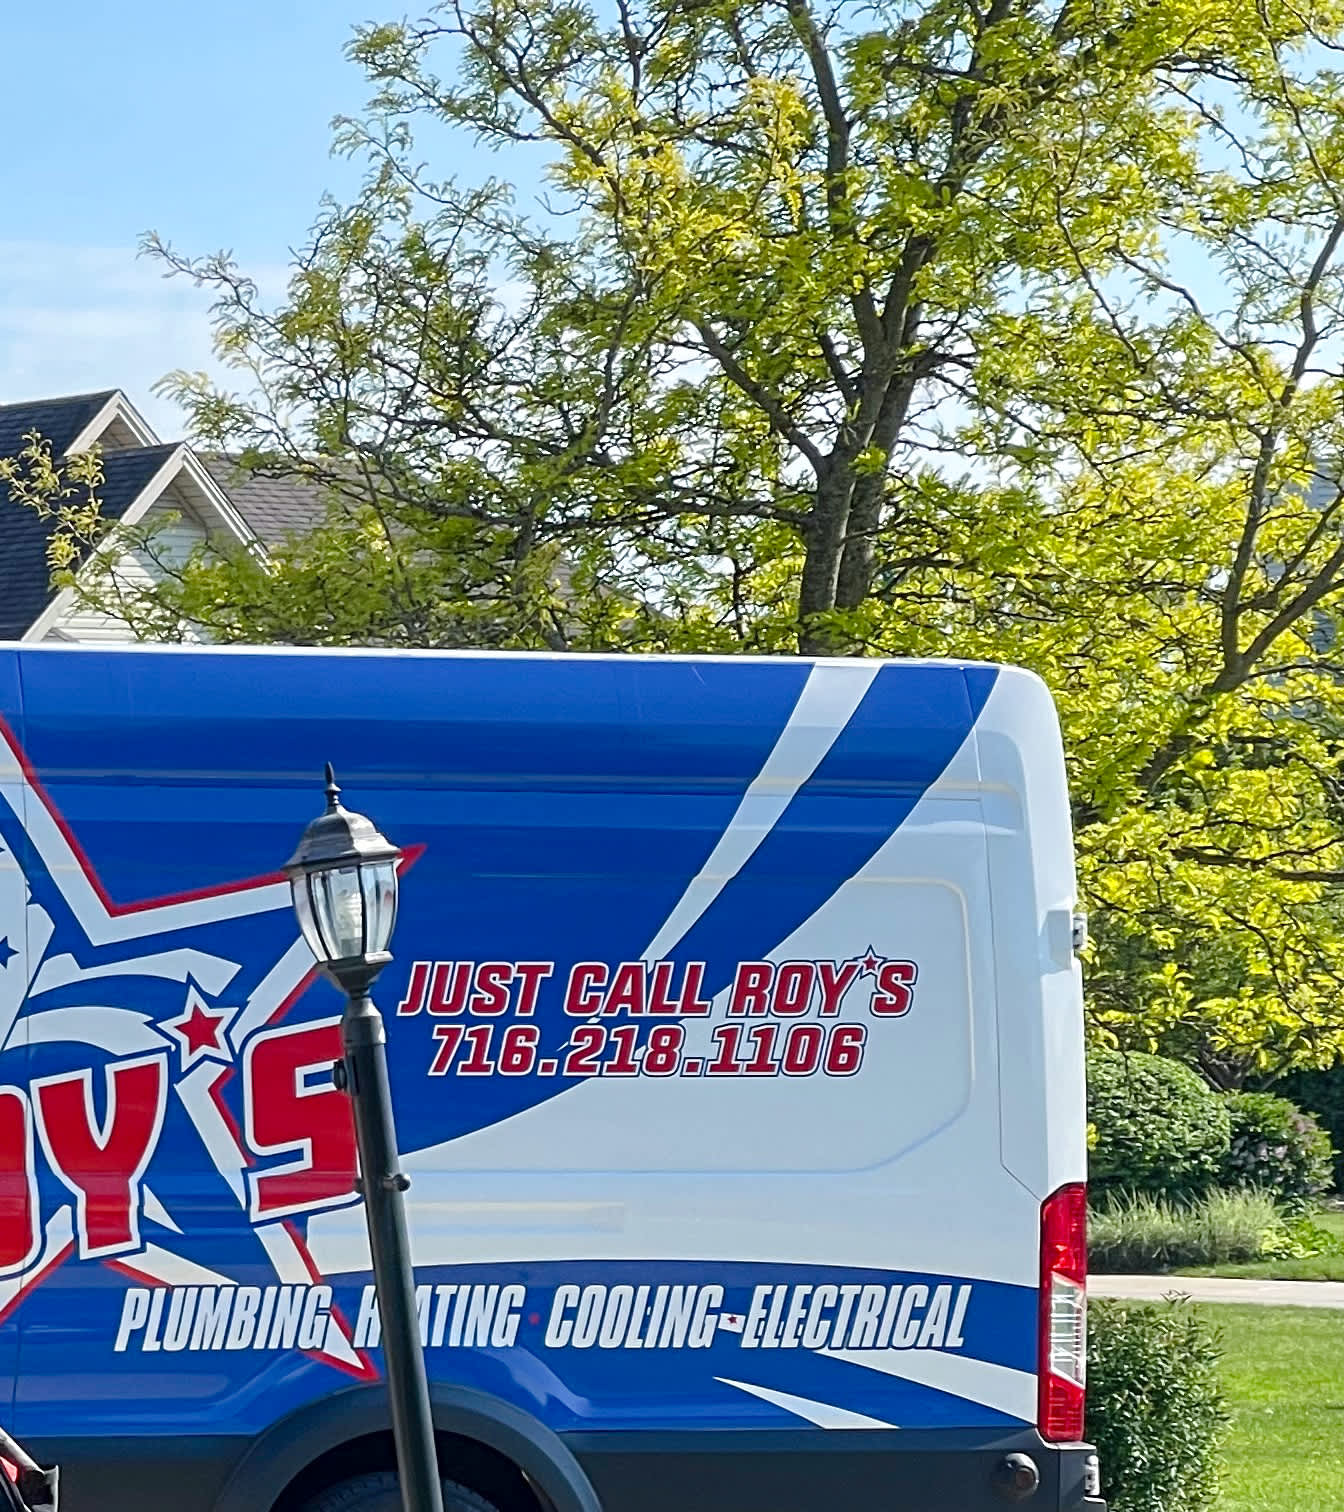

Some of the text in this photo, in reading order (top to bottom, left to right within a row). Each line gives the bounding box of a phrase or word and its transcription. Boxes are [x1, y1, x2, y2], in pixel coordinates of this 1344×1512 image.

[397, 945, 917, 1018] JUST CALL ROY'S
[427, 1023, 868, 1077] 716.218.1106
[114, 1284, 972, 1351] PLUMBING HATING COOLING ELECTRICAL
